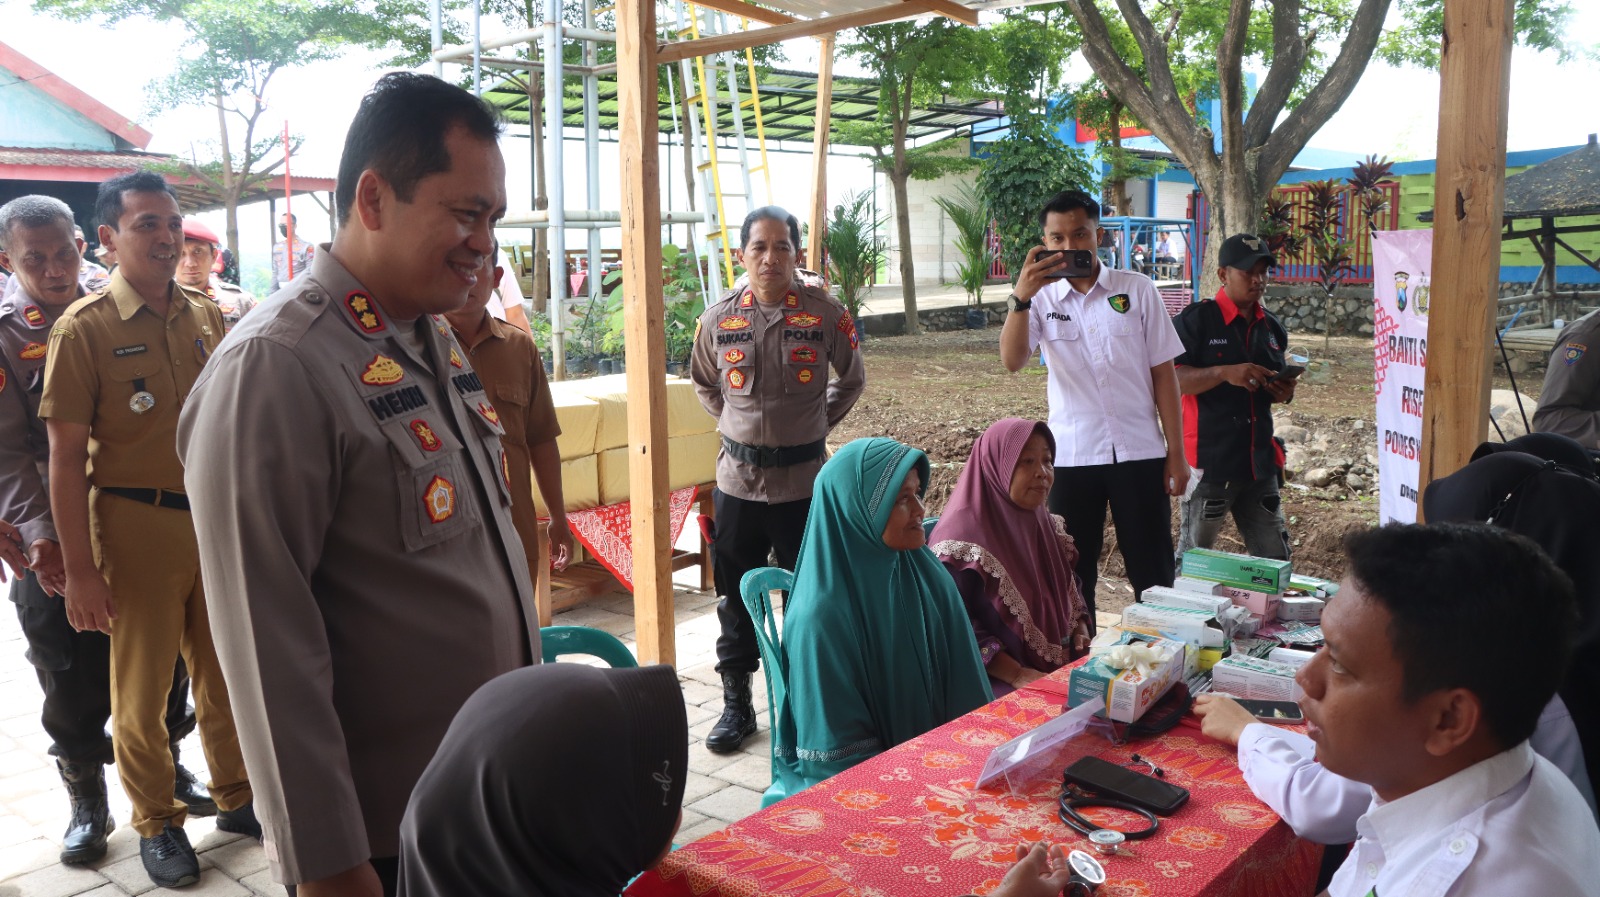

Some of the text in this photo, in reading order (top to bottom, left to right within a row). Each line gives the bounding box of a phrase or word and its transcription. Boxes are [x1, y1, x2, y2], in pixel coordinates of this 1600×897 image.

[1046, 312, 1071, 322] PRADA
[717, 331, 753, 345] SUKACA
[784, 329, 823, 342] POLRI
